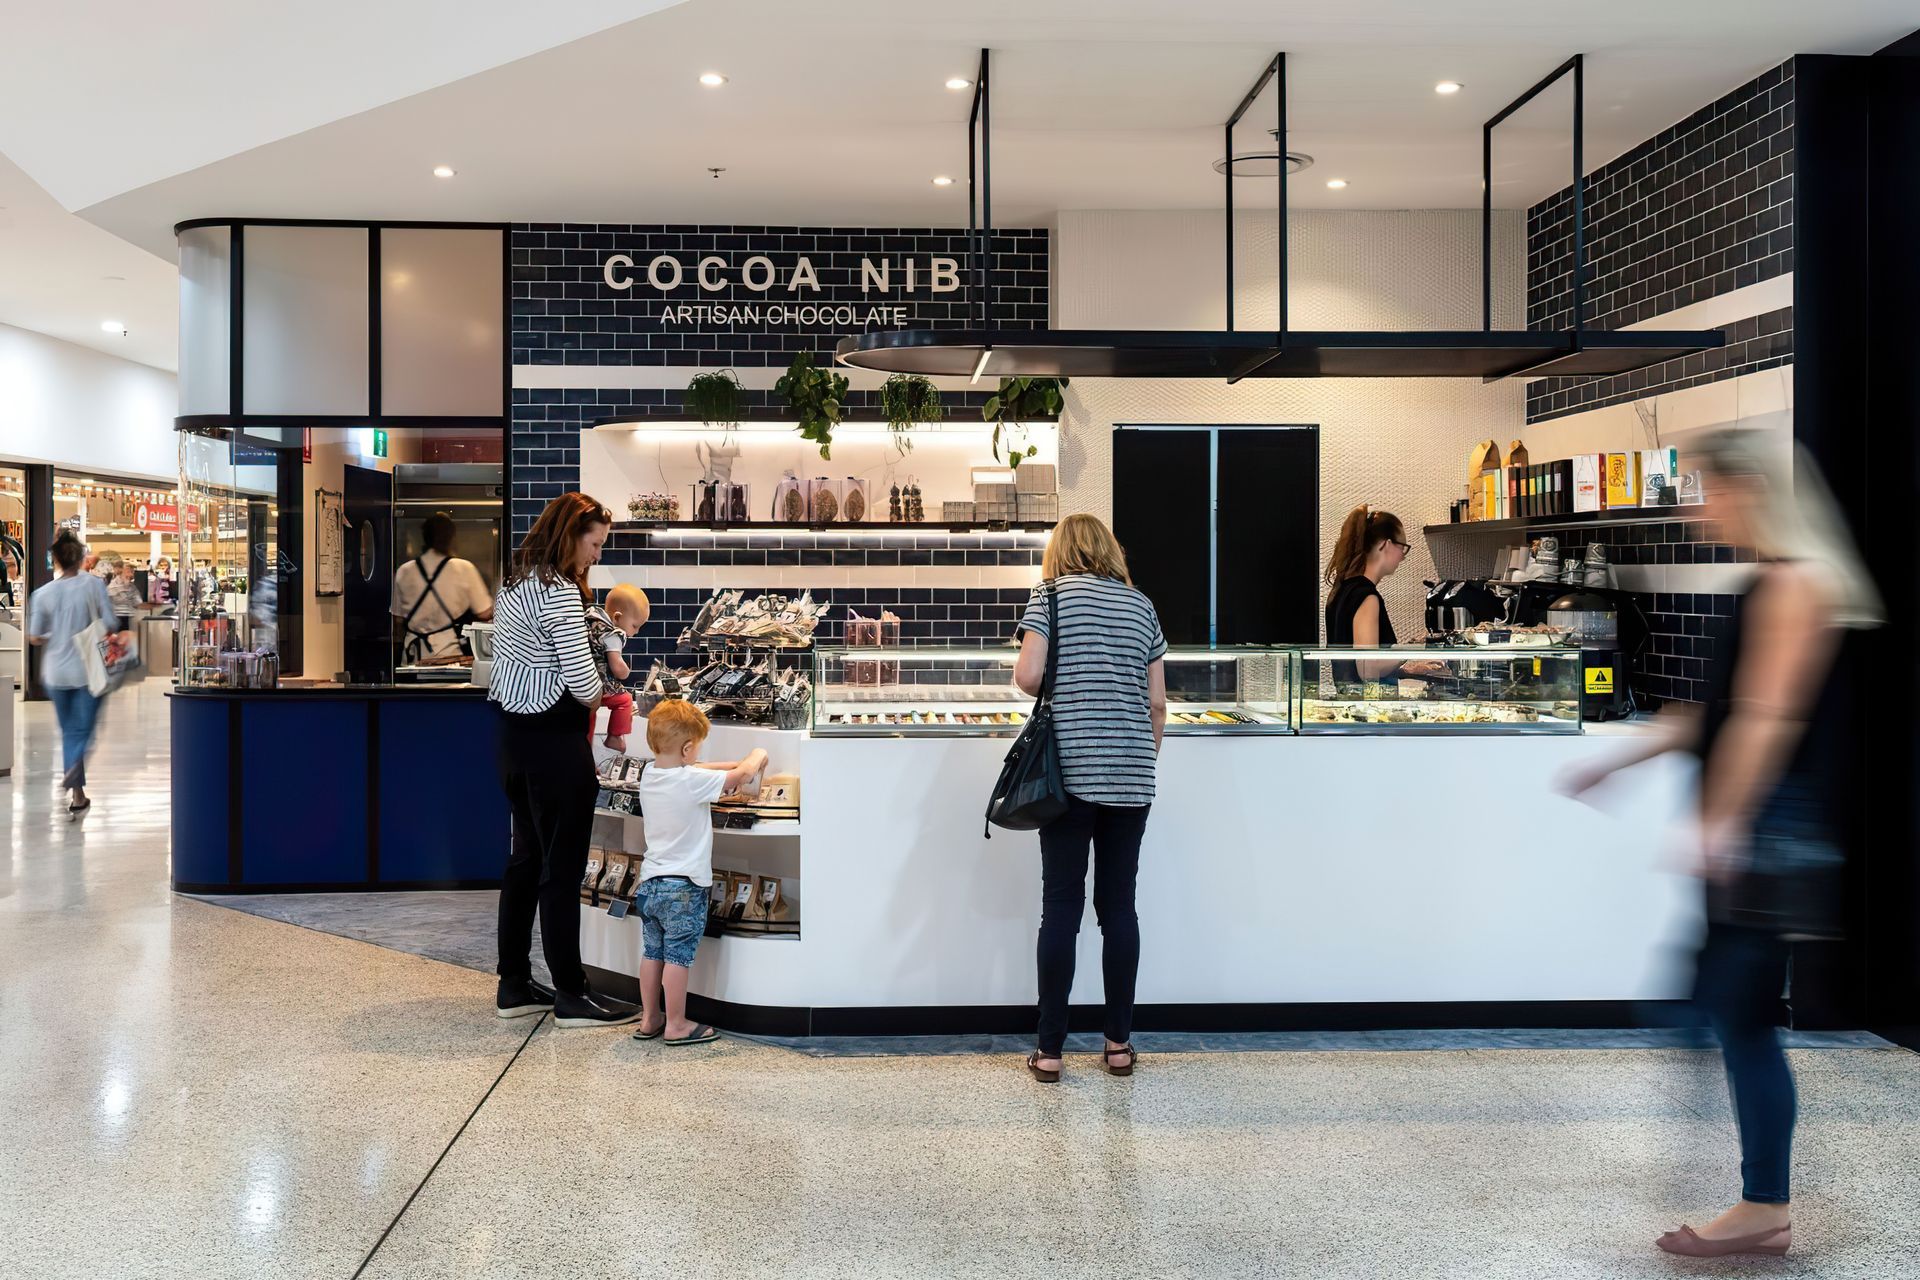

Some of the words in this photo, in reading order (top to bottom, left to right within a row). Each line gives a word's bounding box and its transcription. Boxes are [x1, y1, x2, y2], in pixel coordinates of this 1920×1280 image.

[603, 254, 821, 292] COCOA
[861, 258, 961, 293] NIB
[660, 305, 759, 325] ARTISAN
[766, 306, 908, 326] CHOCOLATE
